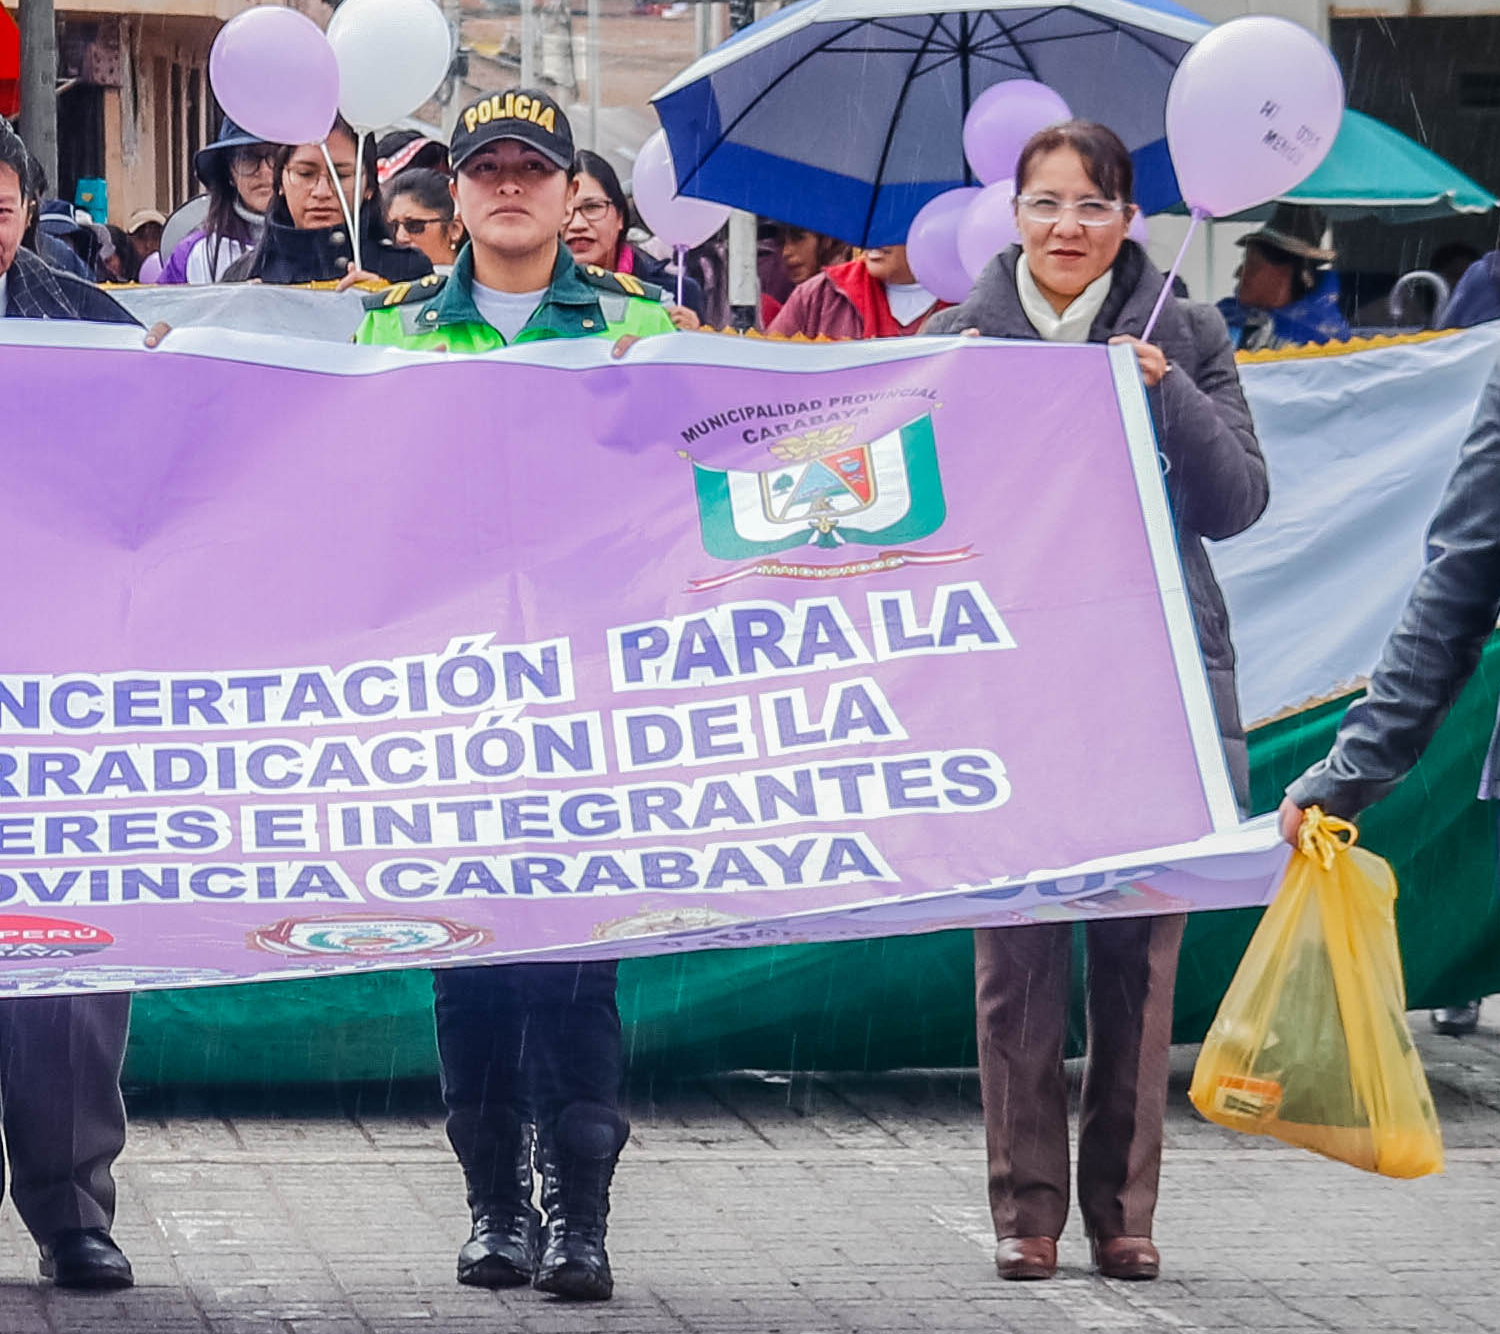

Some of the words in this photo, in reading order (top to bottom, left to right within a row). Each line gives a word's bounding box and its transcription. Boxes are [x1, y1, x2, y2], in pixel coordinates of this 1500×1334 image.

[464, 93, 556, 134] POLICIA
[680, 398, 824, 444] MUNICIPALIDAD
[827, 387, 940, 408] PROVINCIAL
[741, 405, 871, 445] CARABAYA
[620, 603, 857, 683] PARA
[883, 588, 1000, 652] LA
[627, 703, 745, 766] DE
[774, 684, 892, 748] LA
[253, 807, 307, 849] E
[342, 753, 1000, 847] INTEGRANTES
[379, 835, 885, 897] CARABAYA
